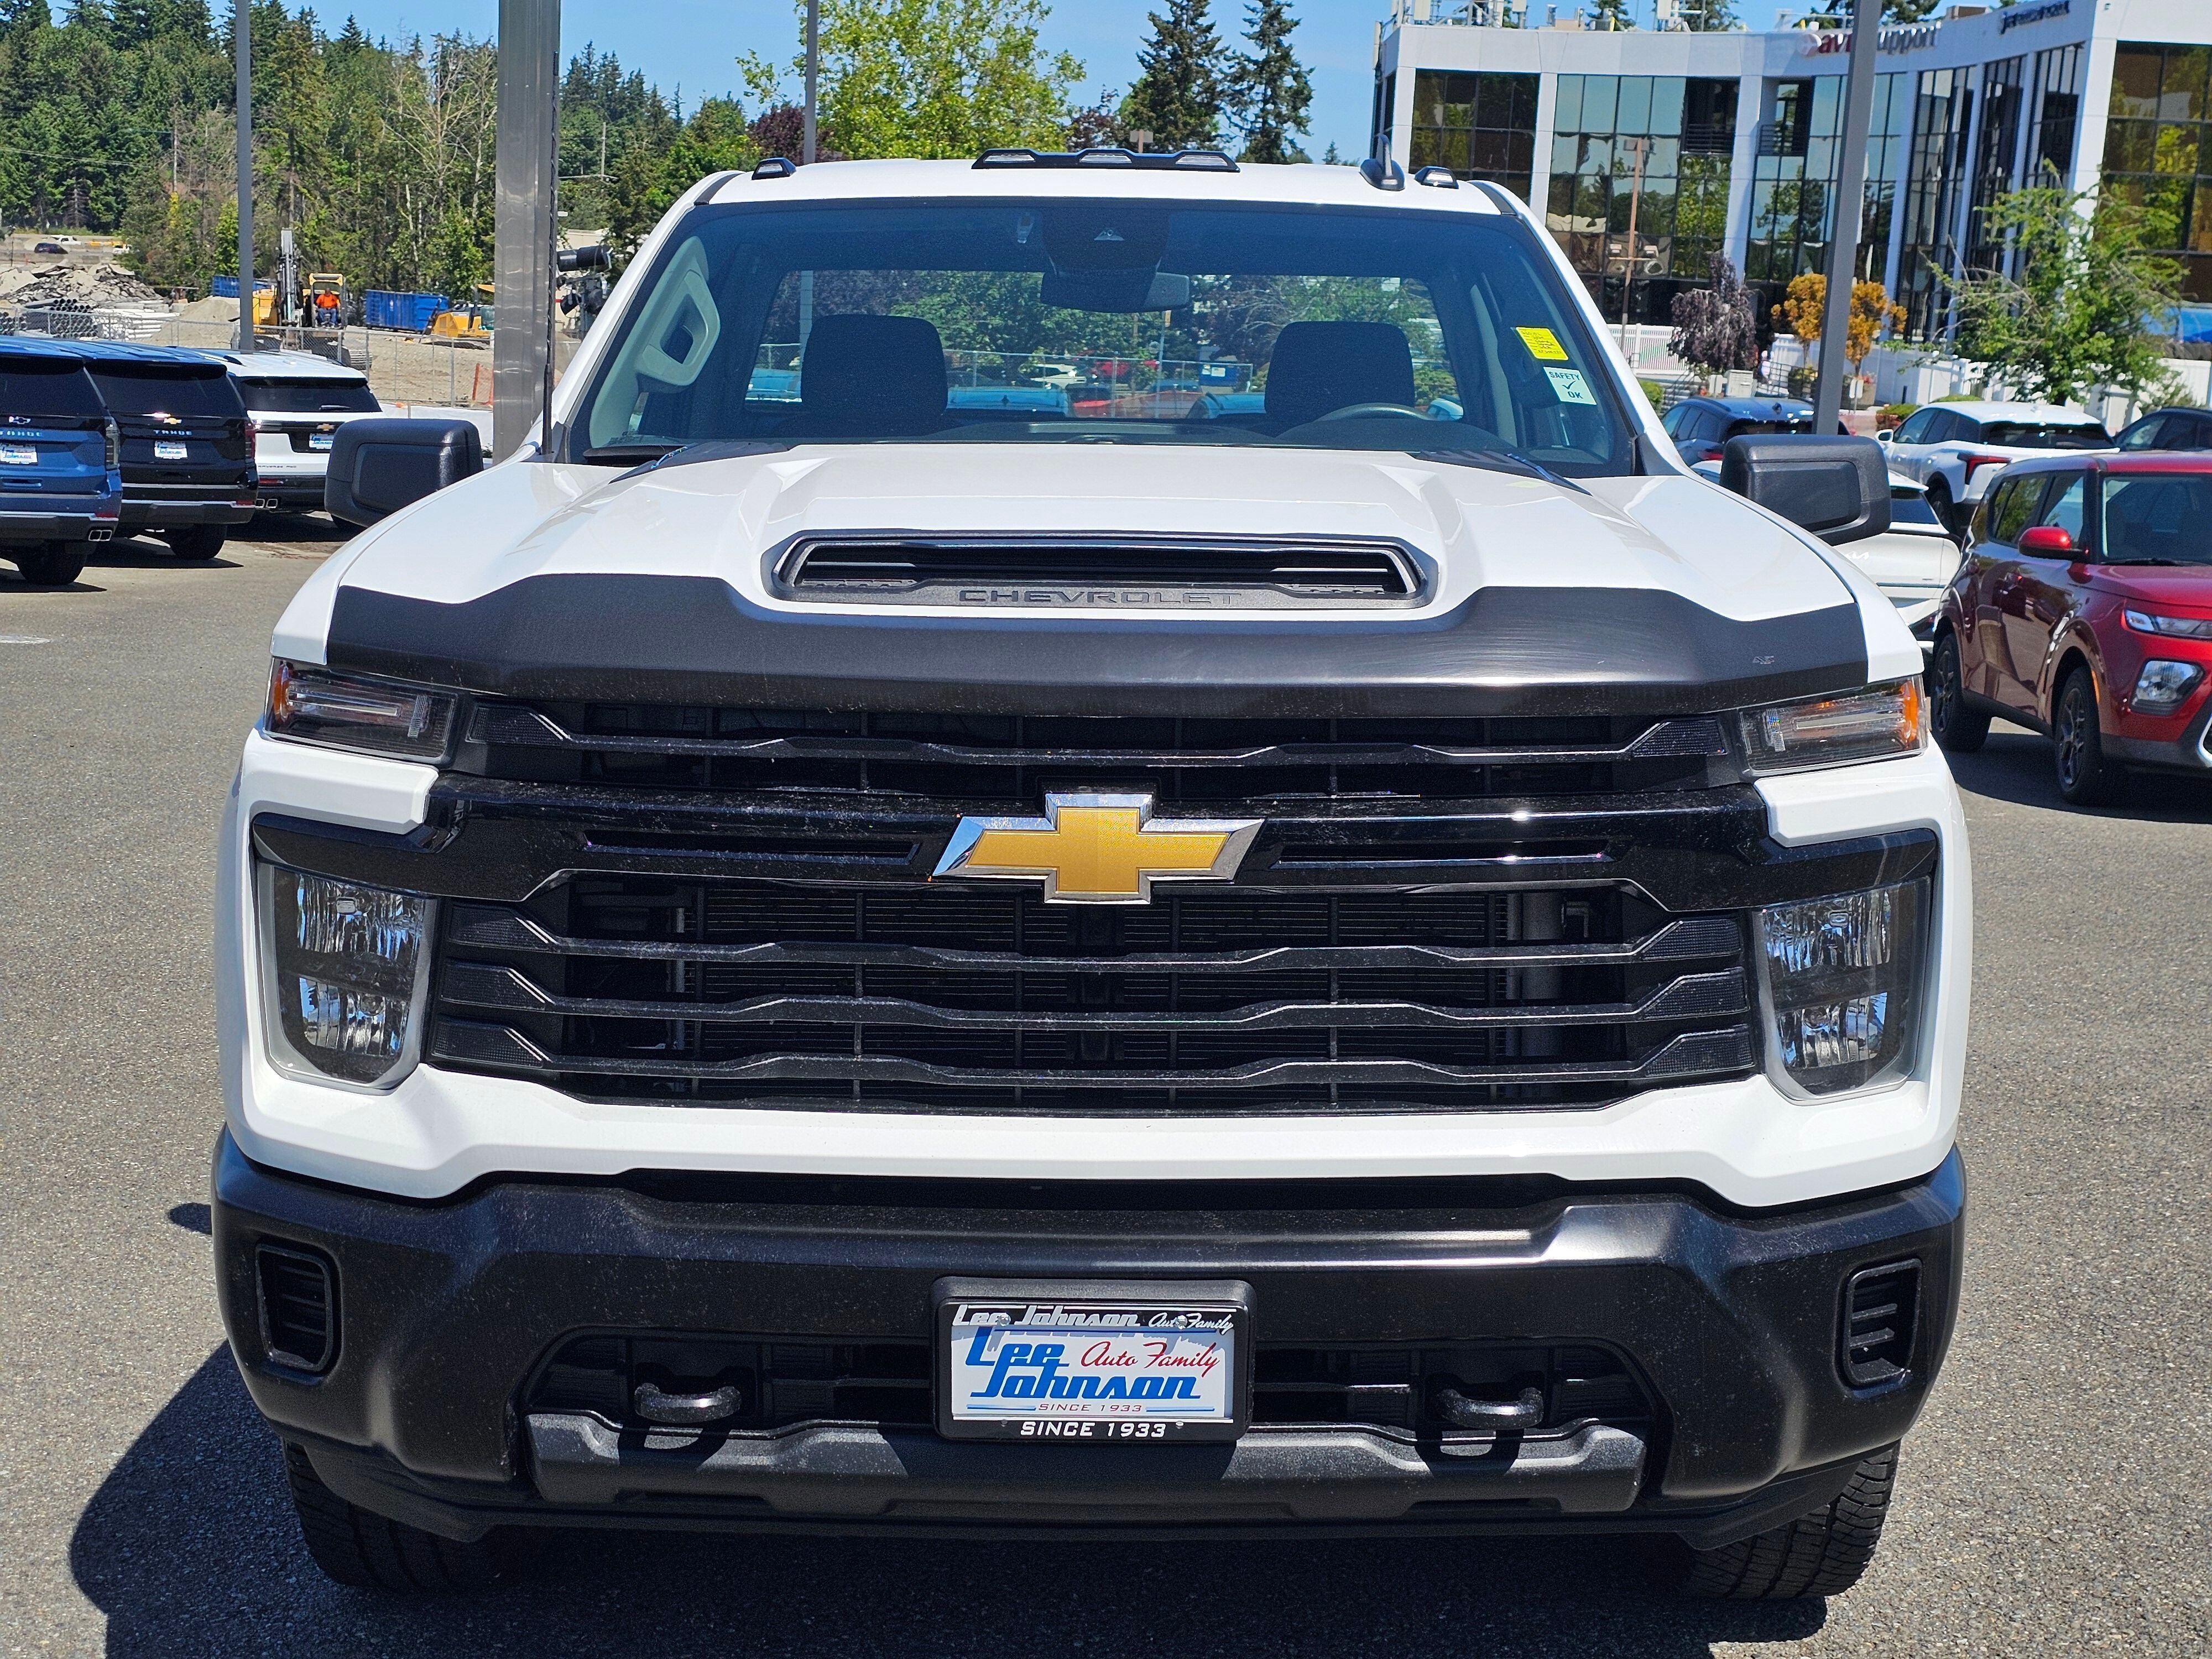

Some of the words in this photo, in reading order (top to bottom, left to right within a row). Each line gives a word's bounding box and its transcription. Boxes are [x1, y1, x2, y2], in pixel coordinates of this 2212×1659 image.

[1548, 371, 1580, 380] SAFETY
[1567, 390, 1583, 399] OK
[959, 589, 1242, 605] CHEVROLET
[1014, 1305, 1141, 1327] Johnson
[1148, 1312, 1179, 1327] Aut
[1186, 1312, 1234, 1335] Family
[965, 1326, 1070, 1366] Lee
[1081, 1341, 1139, 1367] Auto
[1142, 1342, 1220, 1378] Family
[970, 1364, 1201, 1399] Johnson
[1038, 1403, 1092, 1412] SINCE
[1100, 1404, 1142, 1412] 1933
[1020, 1421, 1095, 1437] SINCE
[1107, 1423, 1166, 1438] 1933
